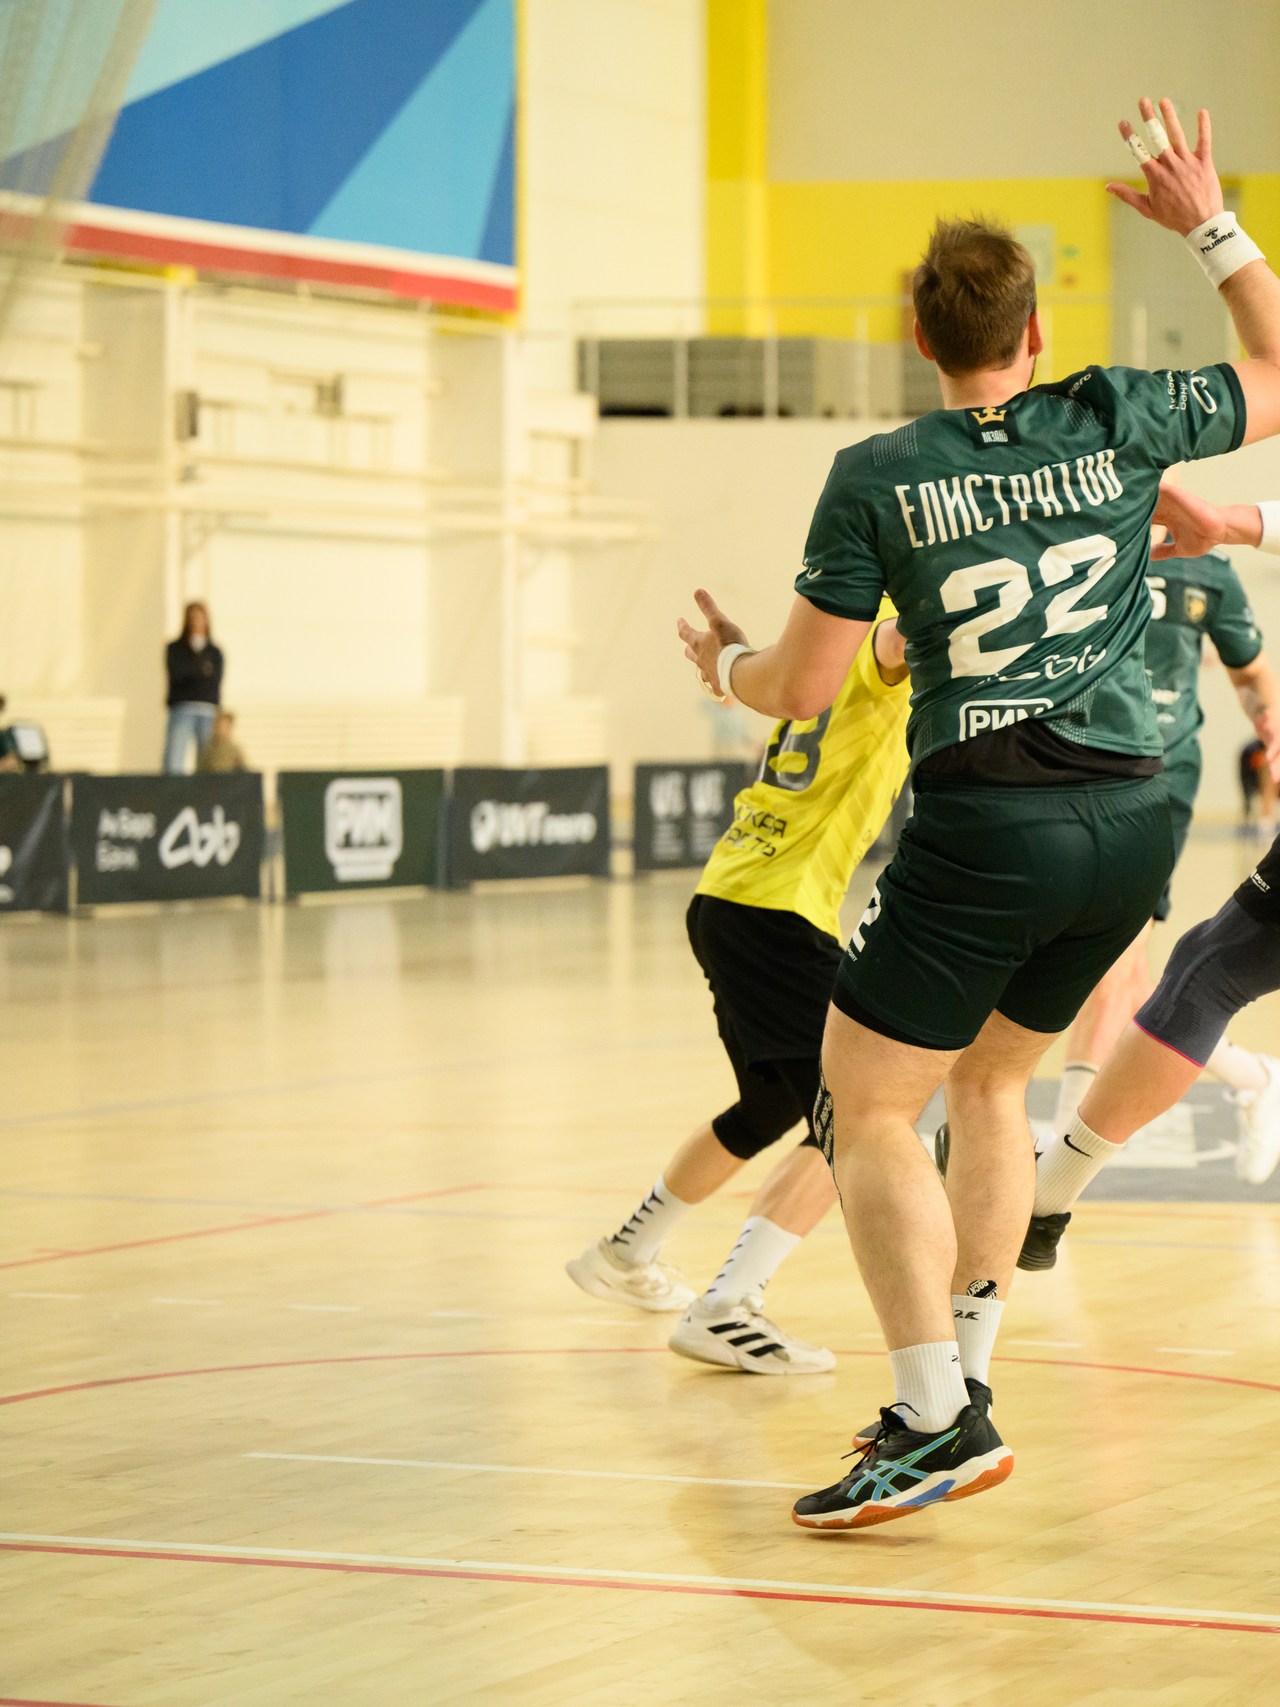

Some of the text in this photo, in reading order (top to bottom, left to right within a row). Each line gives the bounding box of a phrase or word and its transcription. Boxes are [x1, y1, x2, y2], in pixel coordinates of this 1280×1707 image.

[1200, 229, 1237, 255] hummel
[895, 448, 1124, 548] ЕЛИСТРАТОВ
[939, 534, 1117, 679] 22
